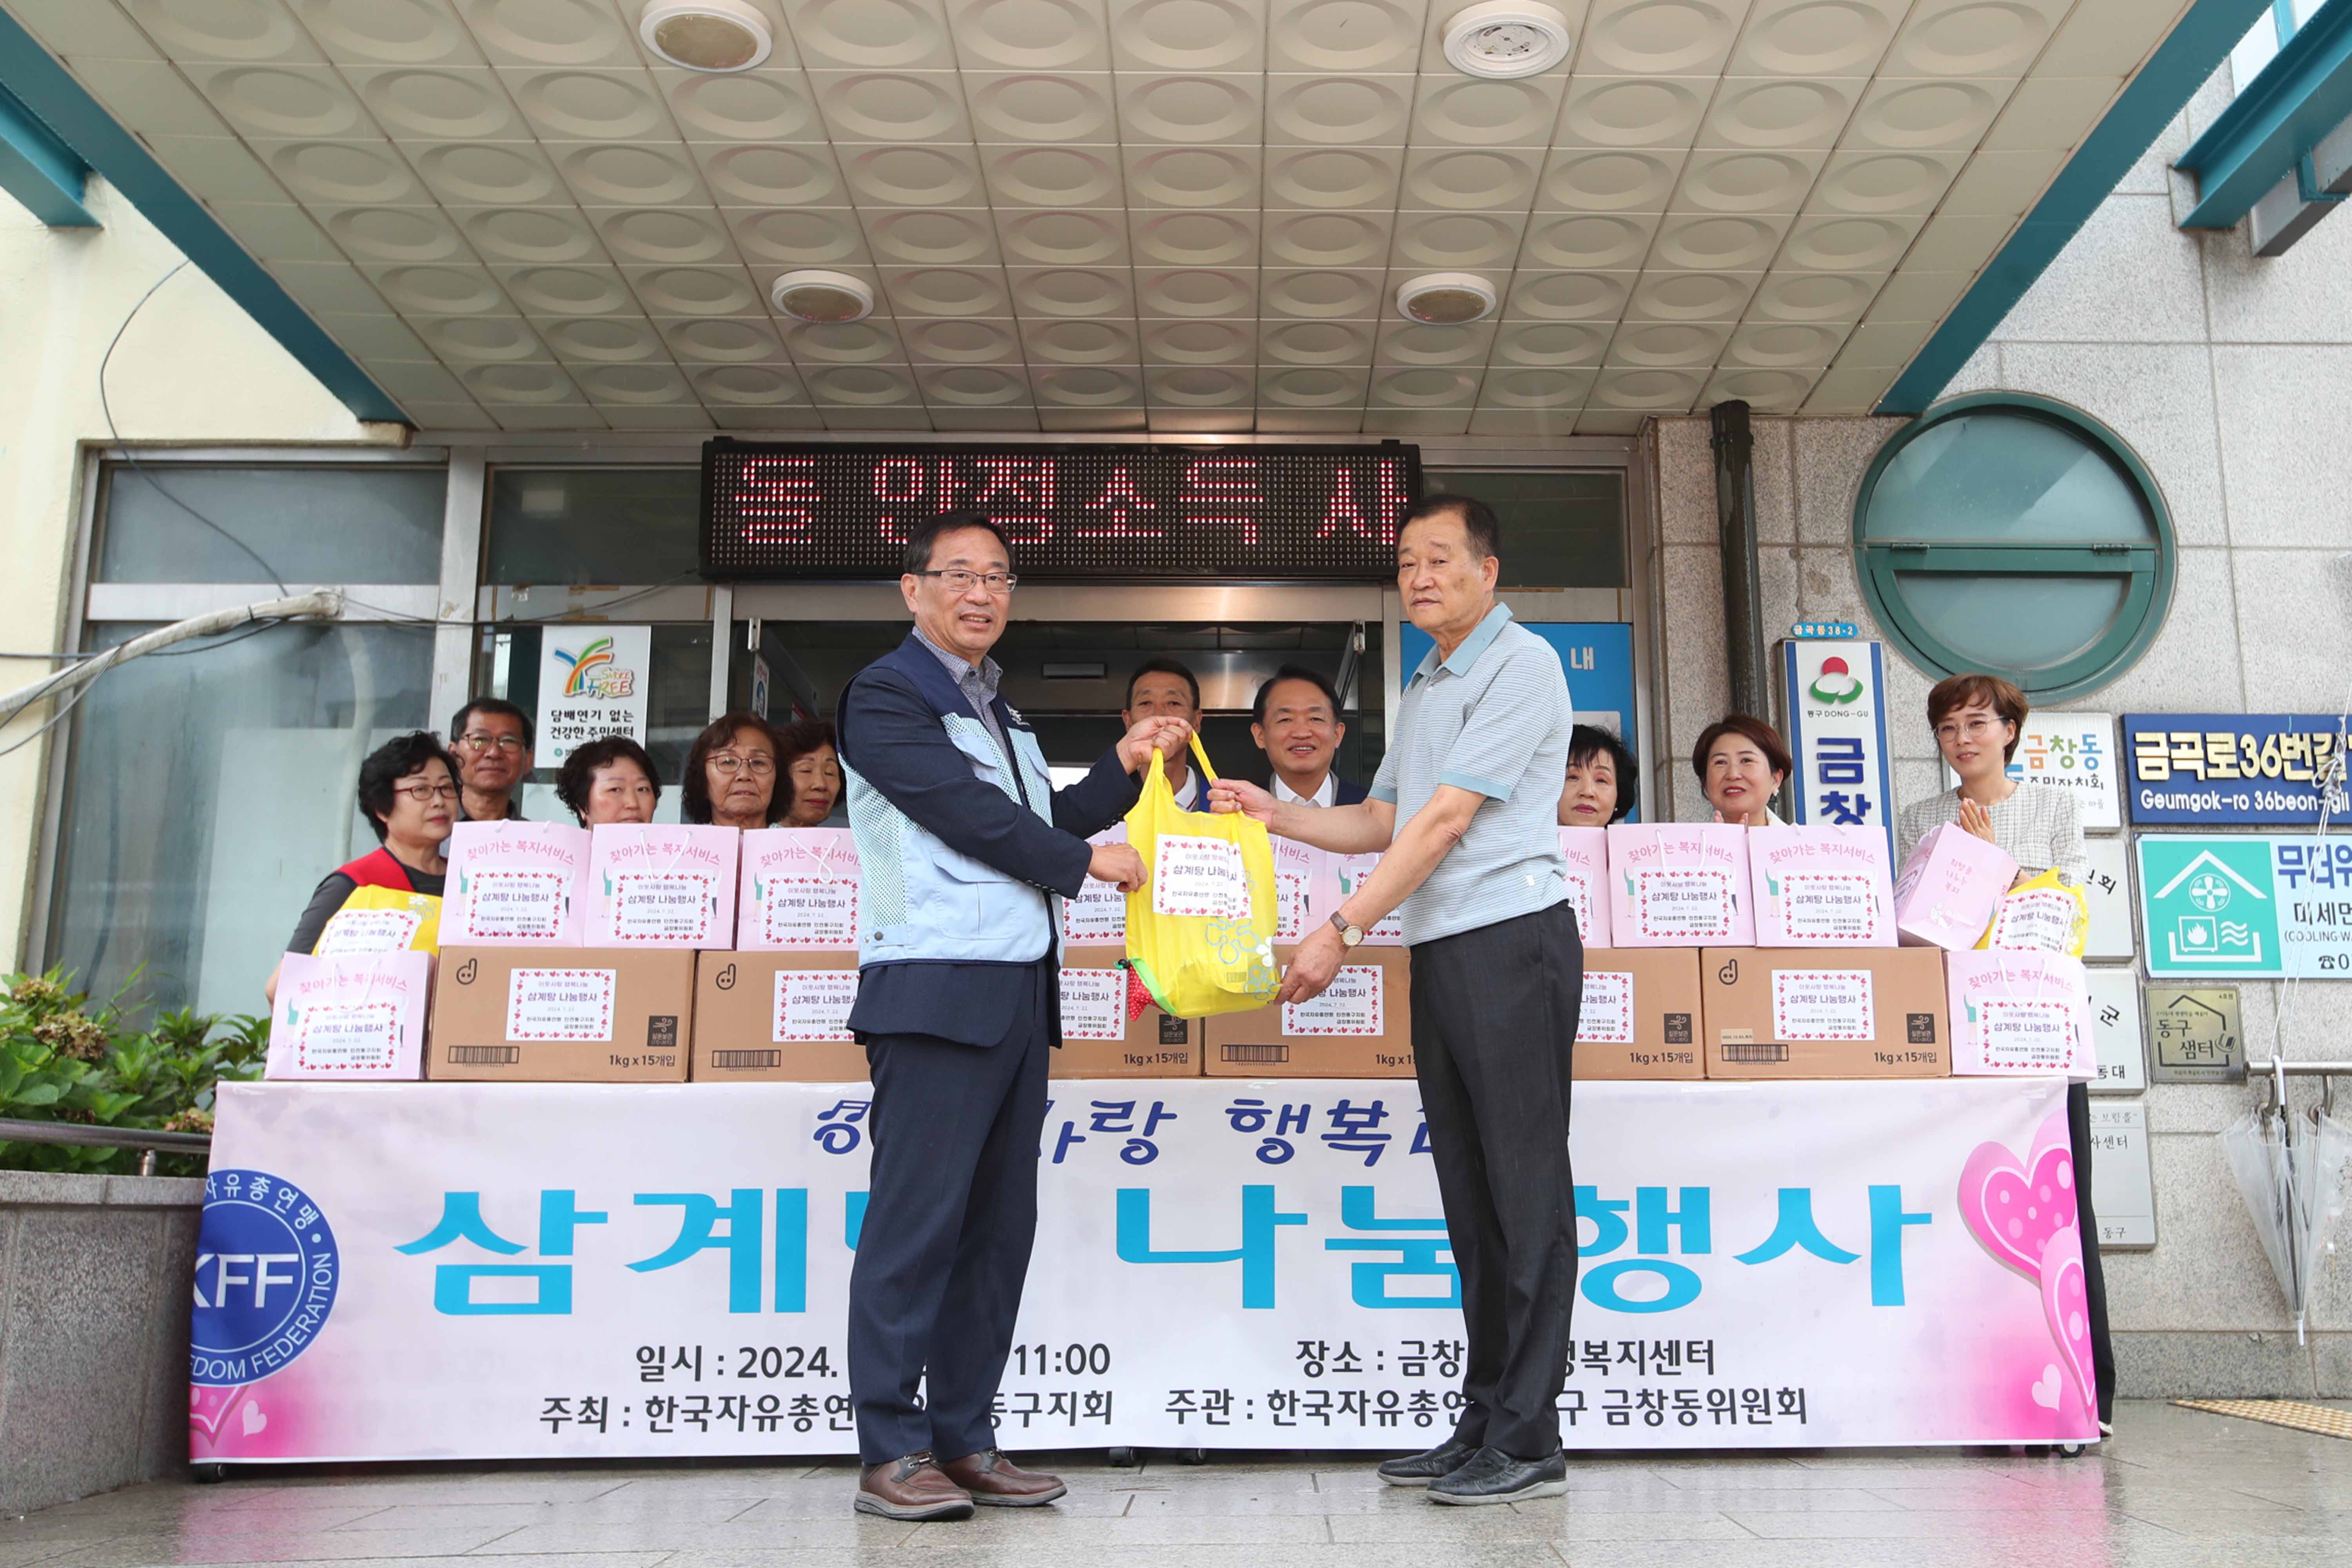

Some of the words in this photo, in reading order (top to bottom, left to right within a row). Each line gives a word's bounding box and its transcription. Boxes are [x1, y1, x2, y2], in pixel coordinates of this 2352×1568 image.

[1570, 647, 1594, 670] 내
[588, 678, 630, 695] FREE
[551, 710, 601, 722] 담배연기
[610, 710, 633, 722] 없는
[551, 726, 584, 739] 건강한
[2024, 734, 2102, 770] 금창동
[1817, 738, 1871, 825] 금창
[2141, 789, 2249, 811] Geumgok-ro
[2254, 791, 2350, 814] 36beon-gil
[467, 840, 512, 860] 찾아가는
[516, 840, 574, 865] 복지서비스
[610, 843, 657, 863] 찾아가는
[662, 843, 720, 865] 복지서비스
[760, 847, 806, 867] 찾아가는
[1628, 842, 1674, 863] 찾아가는
[1679, 841, 1733, 863] 복지서비스
[1769, 844, 1816, 864] 찾아가는
[1820, 843, 1875, 864] 복지서비스
[1173, 865, 1204, 876] 삼계탕
[482, 893, 509, 902] 삼계탕
[512, 893, 549, 902] 나눔행사
[628, 895, 655, 904] 삼계탕
[659, 895, 696, 904] 나눔행사
[778, 899, 805, 908] 삼계탕
[808, 899, 845, 908] 나눔행사
[1651, 892, 1679, 902] 삼계탕
[1682, 891, 1717, 901] 나눔행사
[1796, 895, 1822, 904] 삼계탕
[1826, 895, 1861, 904] 나눔행사
[1968, 969, 2015, 989] 찾아가는
[2020, 969, 2073, 992] 복지서비스
[528, 993, 556, 1002] 삼계탕
[559, 993, 597, 1002] 나눔행사
[792, 996, 820, 1004] 삼계탕
[1073, 992, 1109, 1001] 나눔행사
[1330, 989, 1366, 997] 나눔행사
[1581, 995, 1616, 1004] 나눔행사
[1790, 995, 1817, 1004] 삼계탕
[1820, 995, 1856, 1004] 나눔행사
[313, 1025, 341, 1034] 삼계탕
[345, 1024, 383, 1033] 나눔행사
[1994, 1023, 2021, 1032] 삼계탕
[2024, 1023, 2060, 1033] 나눔행사
[2156, 1020, 2192, 1038] 동구
[610, 1055, 630, 1068] 1kg
[642, 1055, 675, 1067] 15개입
[1124, 1053, 1143, 1066] 1kg
[1155, 1053, 1188, 1064] 15개입
[1376, 1054, 1395, 1067] 1kg
[1630, 1053, 1650, 1065] 1kg
[1661, 1053, 1693, 1063] 15개입
[1874, 1052, 1893, 1065] 1kg
[1905, 1052, 1937, 1063] 15개입
[2097, 1065, 2125, 1080] 동대
[1226, 1099, 1437, 1167] 행복
[2091, 1135, 2128, 1149] 사센터
[392, 1189, 870, 1315] 삼계
[251, 1252, 332, 1374] FEDERATION
[636, 1345, 702, 1383] 일시
[738, 1347, 838, 1379] 2024.
[1014, 1343, 1110, 1376] 11:00
[1296, 1340, 1363, 1378] 장소
[1398, 1340, 1465, 1377] 금창
[540, 1396, 608, 1434] 주최
[645, 1394, 855, 1433] 한국자유총연
[991, 1390, 1112, 1429] 동구지회
[1165, 1389, 1234, 1425] 주관
[1267, 1388, 1462, 1428] 한국자유총연
[1602, 1387, 1807, 1427] 금창동위원회
